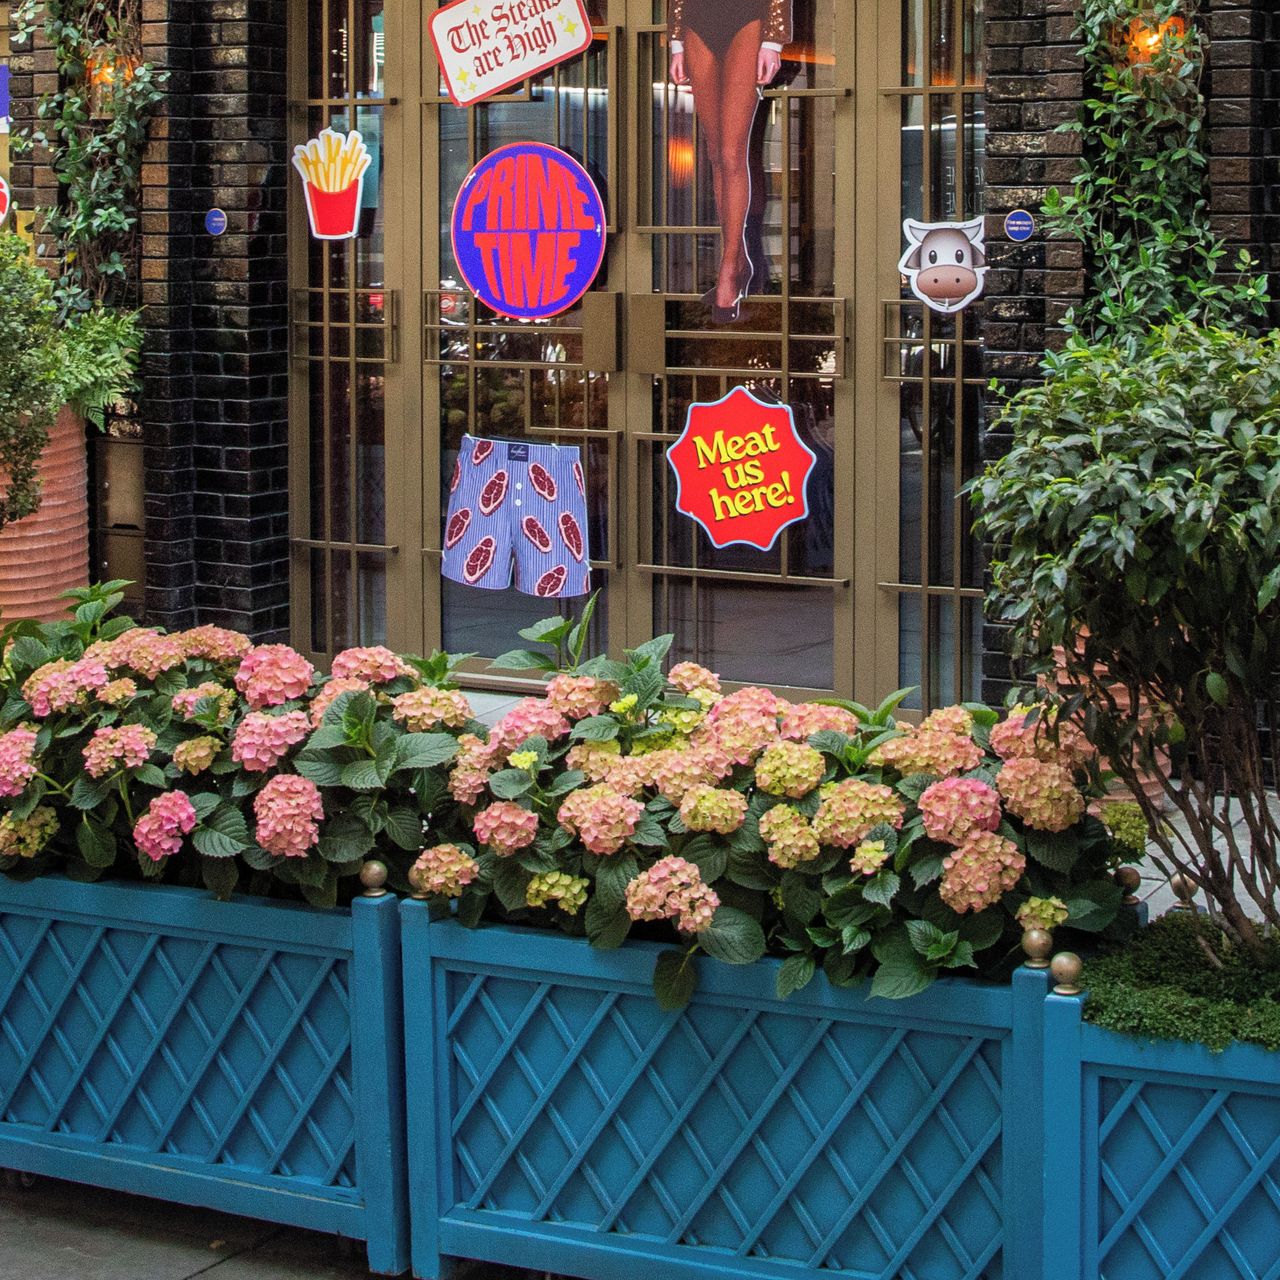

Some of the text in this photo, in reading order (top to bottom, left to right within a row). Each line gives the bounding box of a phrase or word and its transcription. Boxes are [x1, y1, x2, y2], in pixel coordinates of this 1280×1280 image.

[447, 17, 491, 53] The
[473, 46, 504, 77] are
[461, 153, 596, 231] PRIME
[473, 232, 582, 309] TIME
[692, 423, 781, 469] Meat
[709, 471, 795, 521] here!
[722, 459, 764, 490] us
